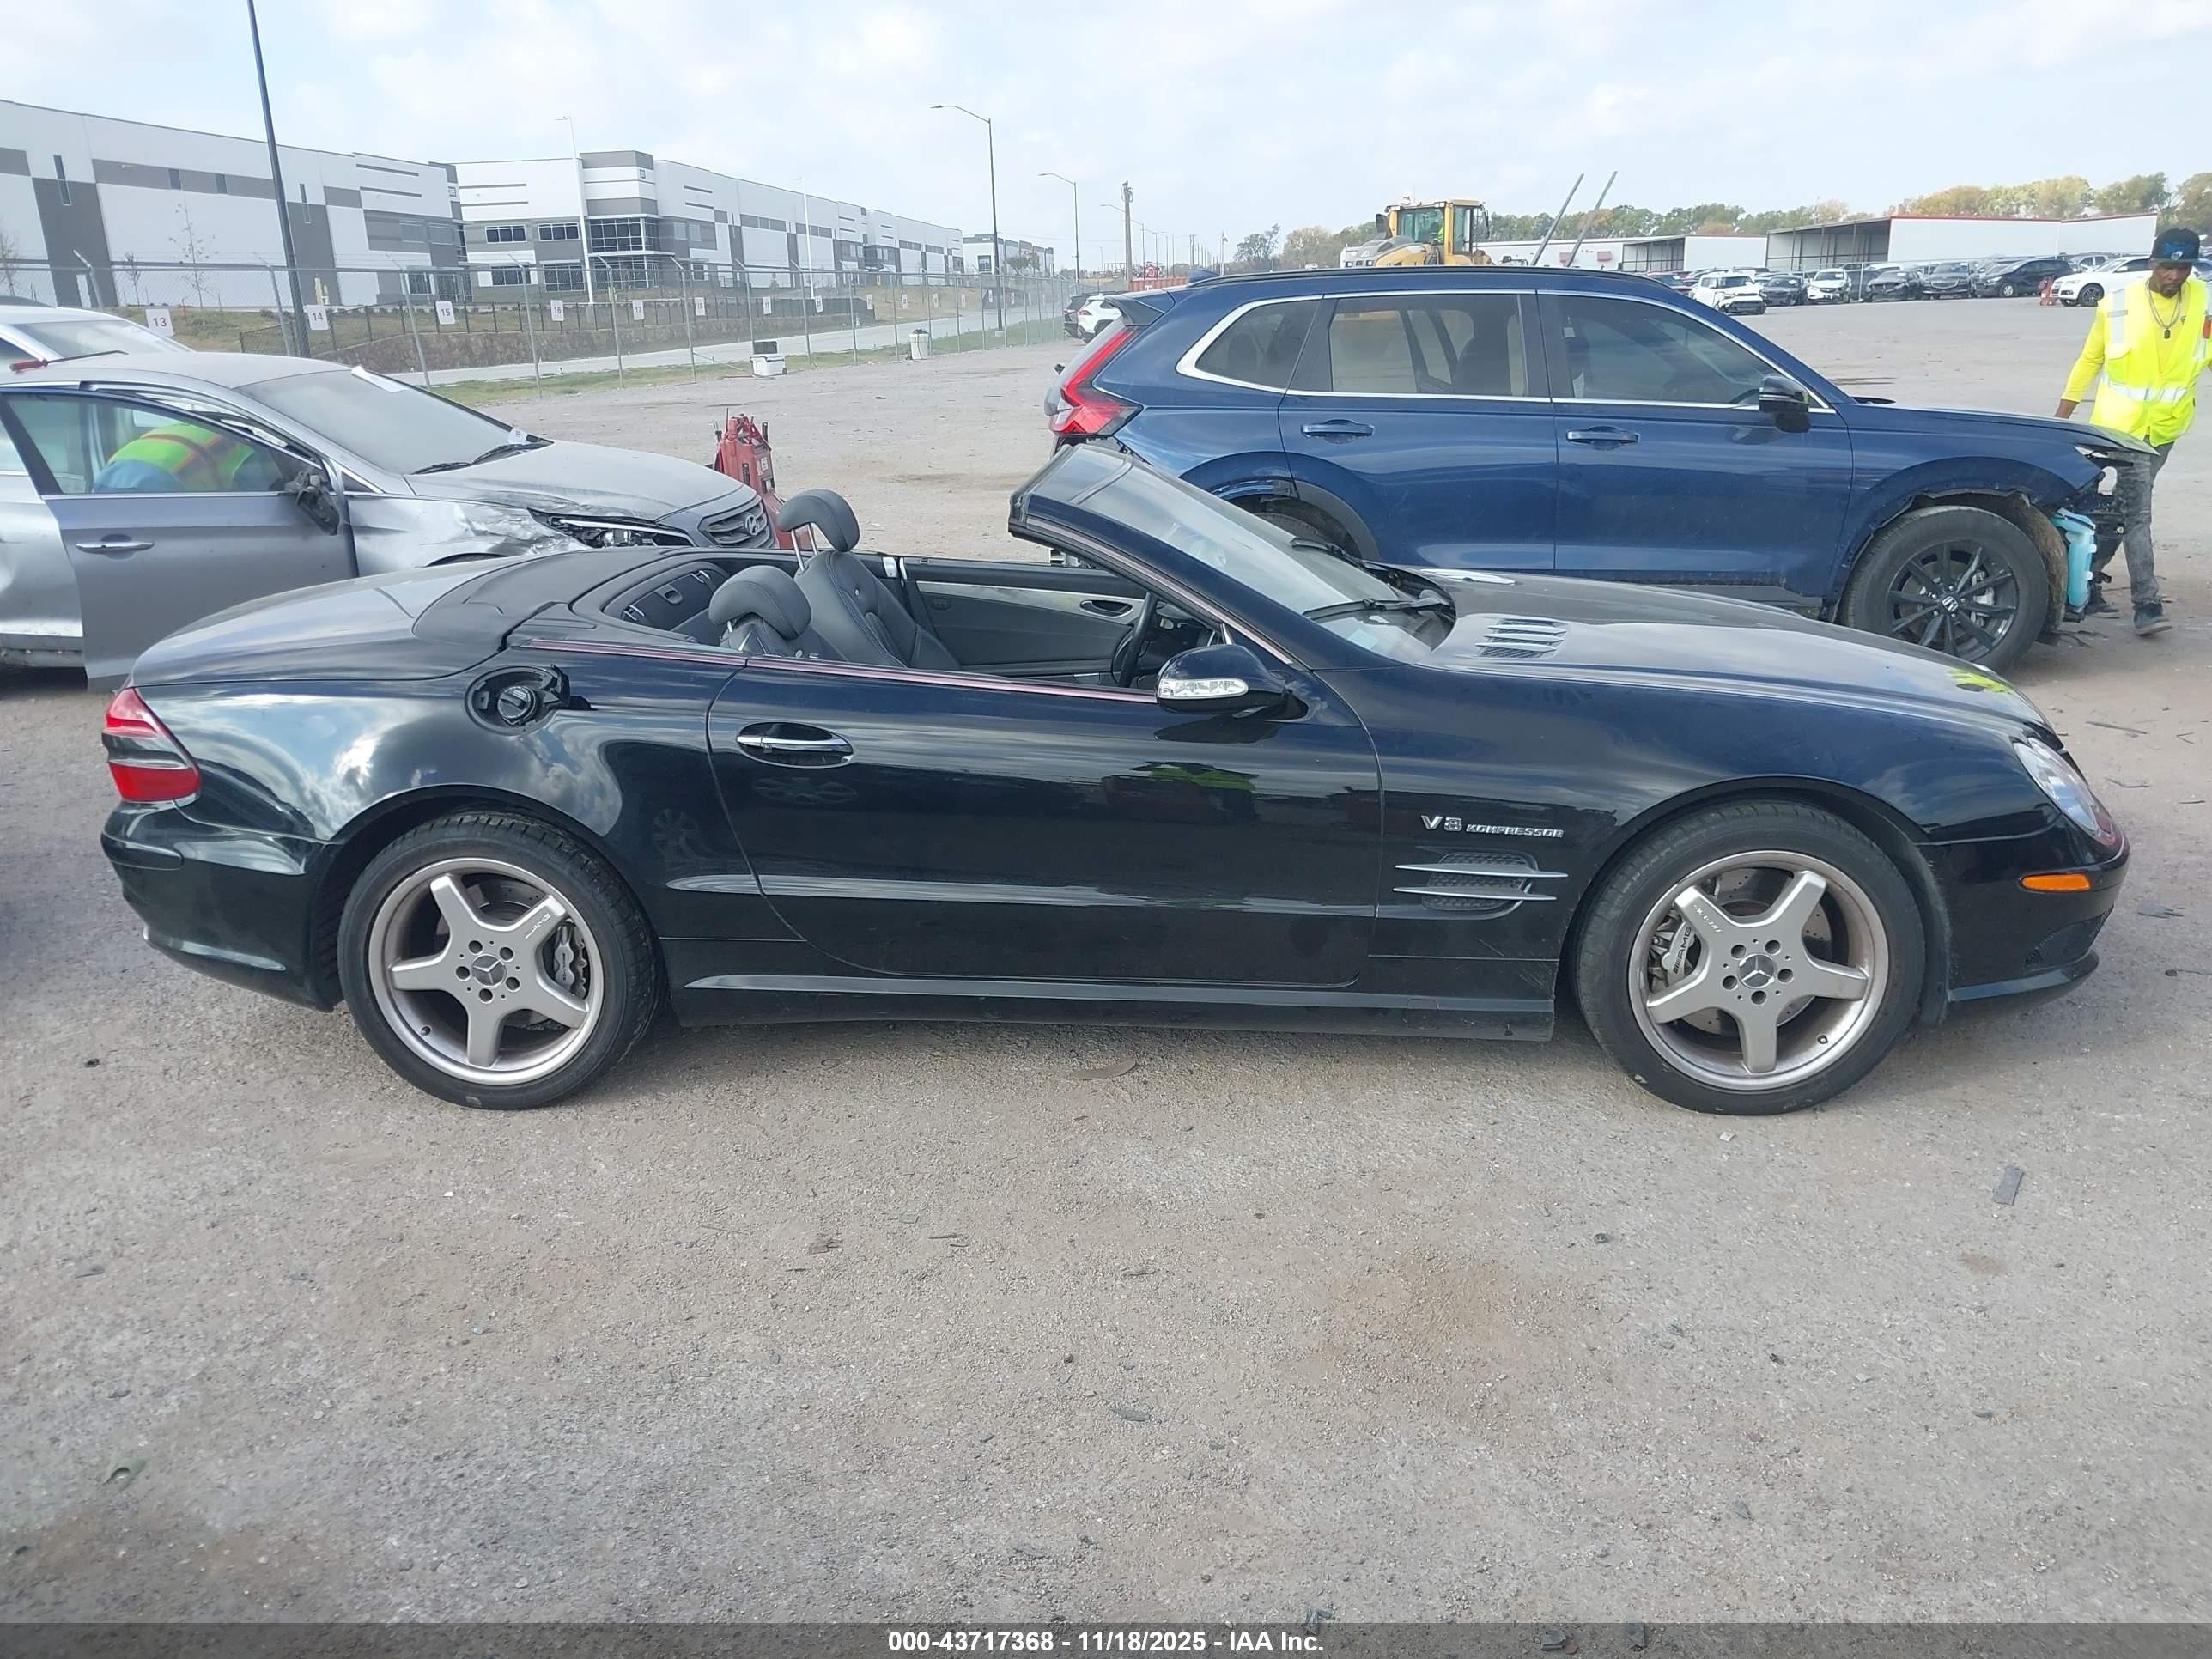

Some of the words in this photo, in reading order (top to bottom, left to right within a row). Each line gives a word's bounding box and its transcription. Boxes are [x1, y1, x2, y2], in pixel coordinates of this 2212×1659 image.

[313, 312, 324, 320] 14
[441, 307, 451, 316] 15
[153, 318, 167, 327] 13
[1466, 824, 1565, 838] KOMPRESSOR
